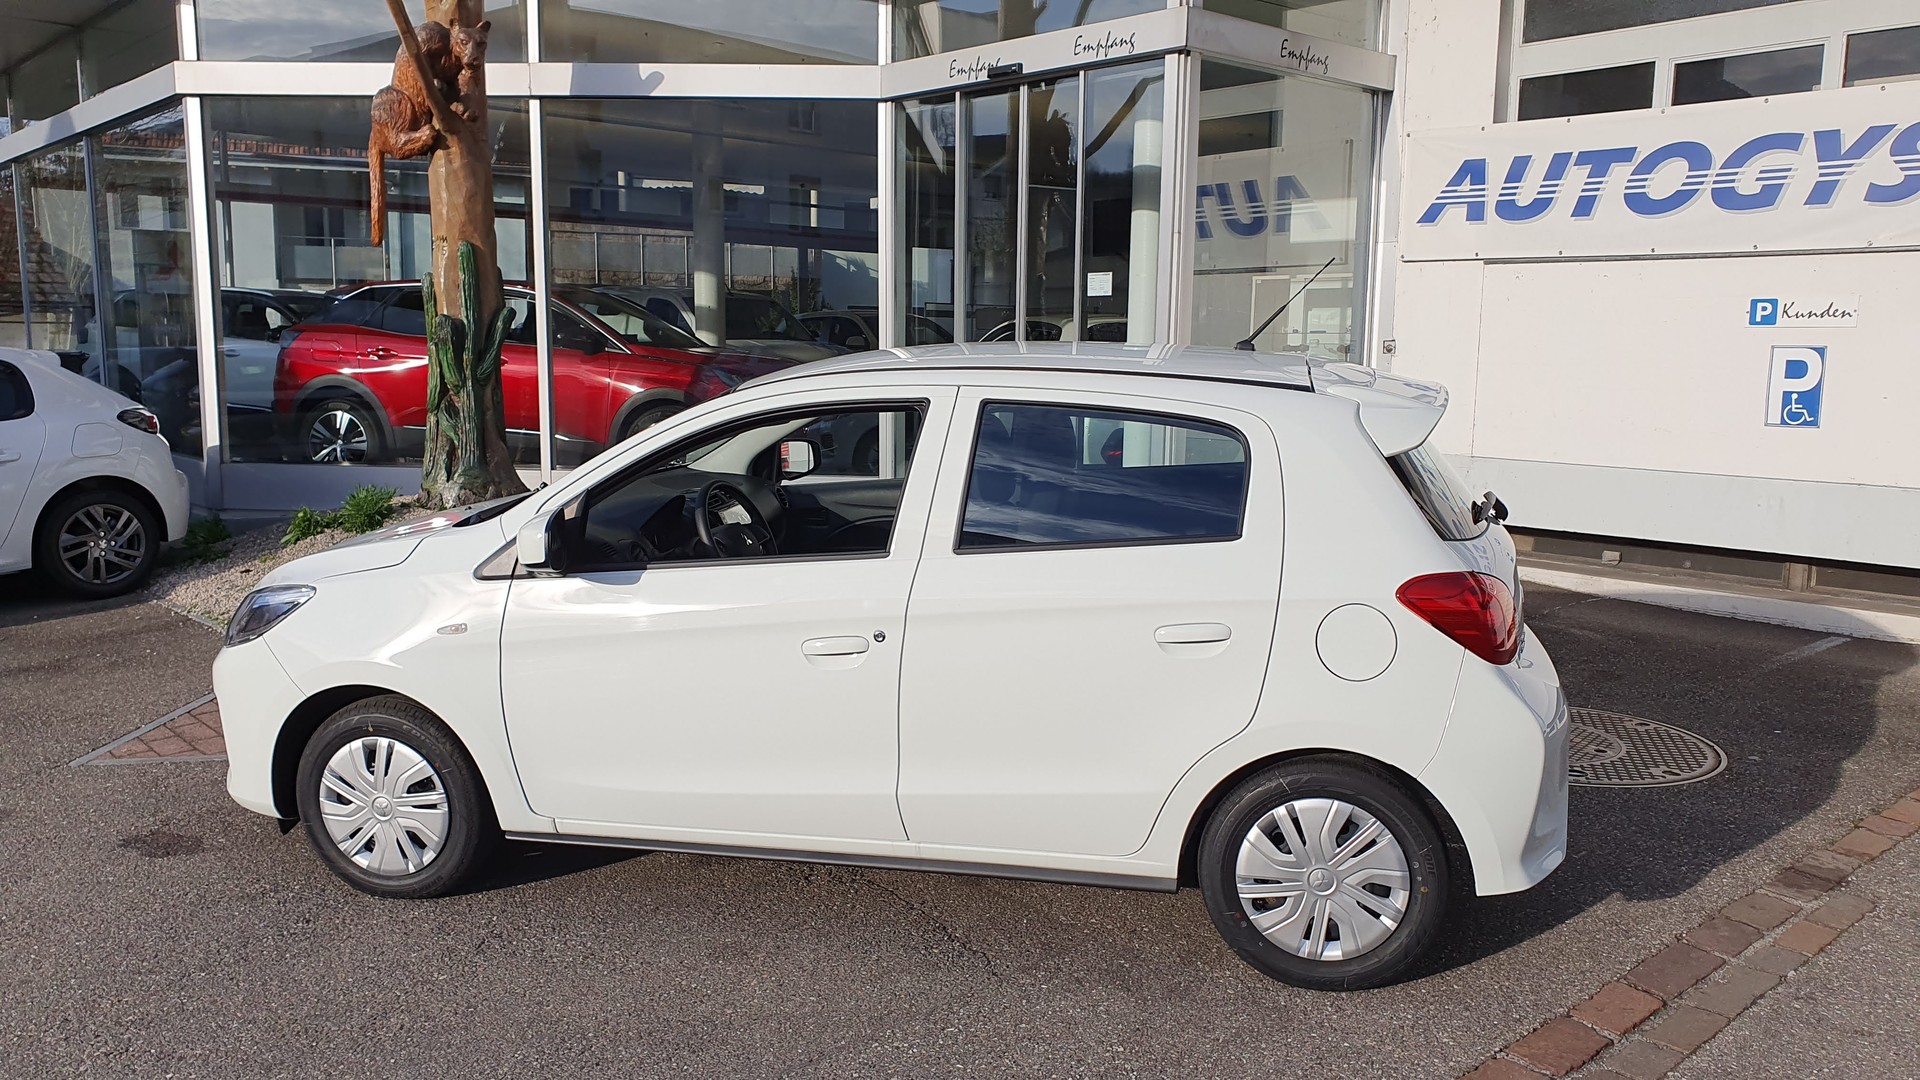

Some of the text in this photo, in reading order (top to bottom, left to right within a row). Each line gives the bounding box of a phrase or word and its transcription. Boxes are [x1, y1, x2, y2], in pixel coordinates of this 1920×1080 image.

[1073, 30, 1137, 59] Empfang
[1281, 38, 1329, 75] Empfang
[1756, 301, 1853, 322] P Kunden
[1766, 346, 1823, 425] P
